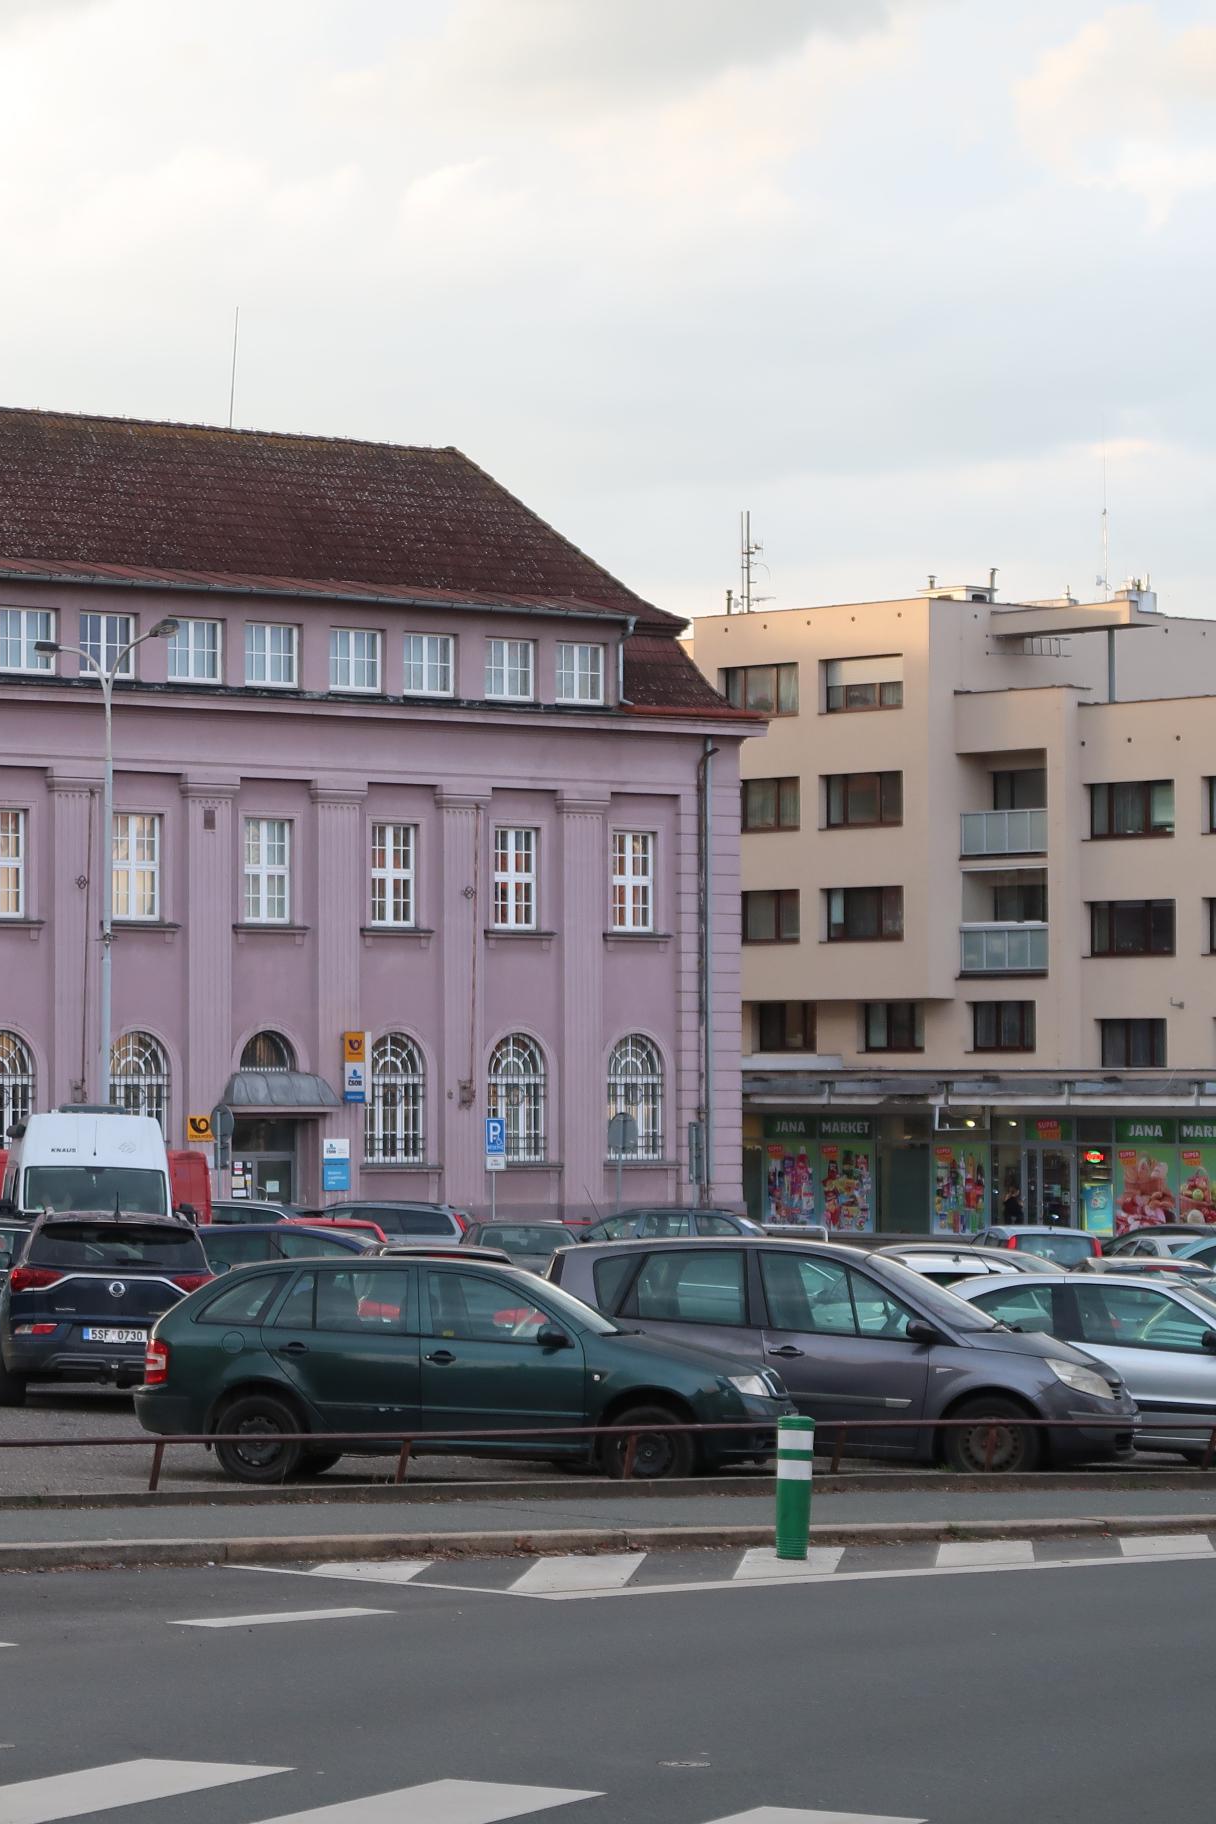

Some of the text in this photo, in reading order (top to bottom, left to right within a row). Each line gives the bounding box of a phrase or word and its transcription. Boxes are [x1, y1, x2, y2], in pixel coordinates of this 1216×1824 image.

[489, 1122, 501, 1143] P
[775, 1121, 870, 1134] JANA MARKET
[1129, 1124, 1163, 1137] JANA
[91, 1329, 143, 1341] 5SF 0730
